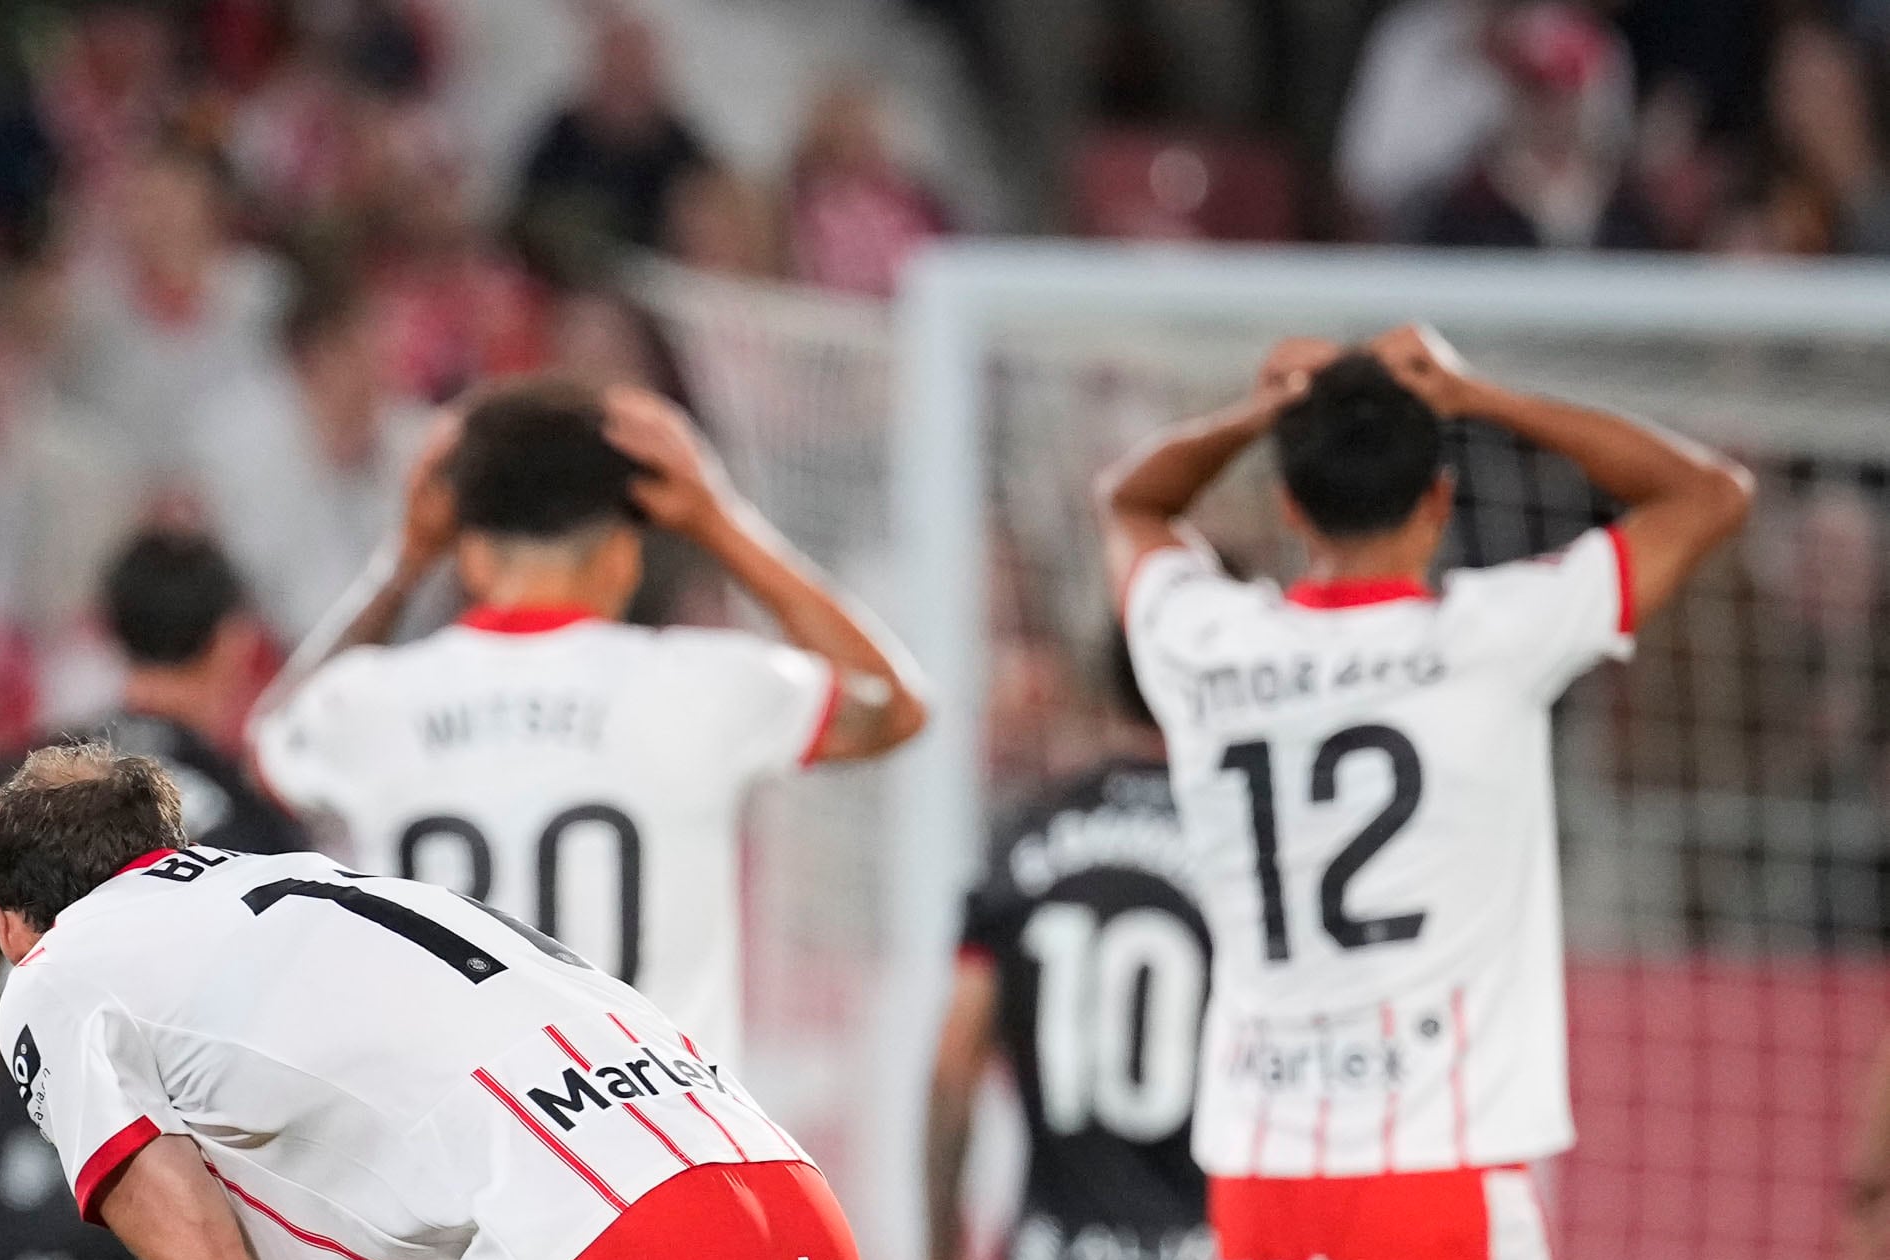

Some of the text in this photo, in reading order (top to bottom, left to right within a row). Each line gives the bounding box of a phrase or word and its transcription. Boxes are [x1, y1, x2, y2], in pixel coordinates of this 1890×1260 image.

[240, 868, 598, 985] 1
[1218, 724, 1426, 962] 12
[1020, 900, 1210, 1143] 10
